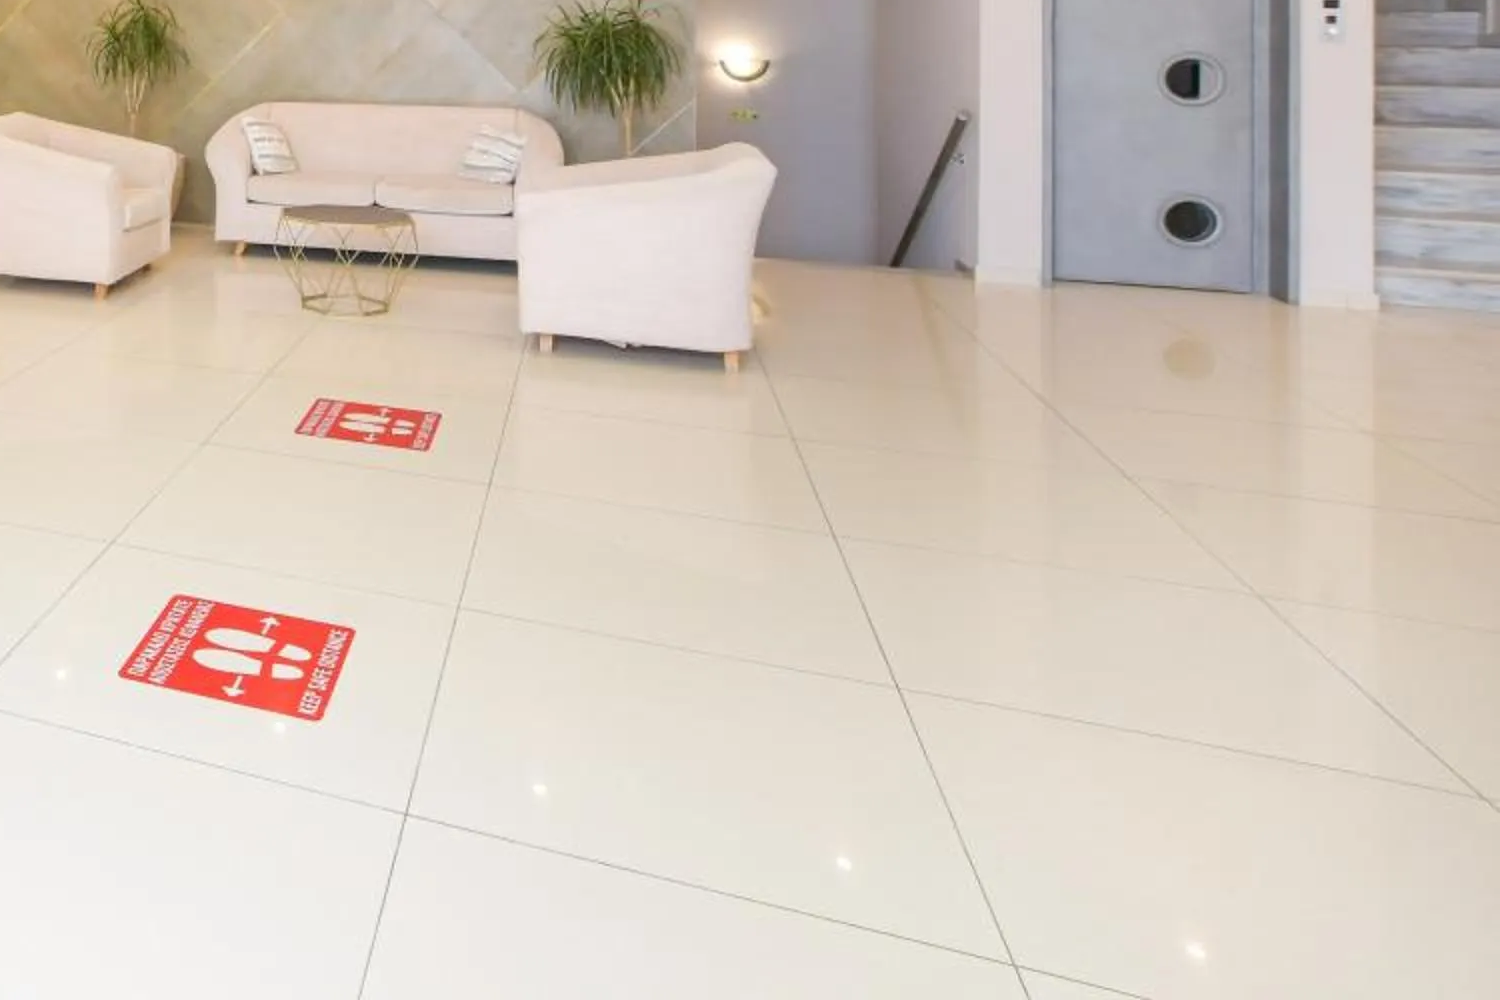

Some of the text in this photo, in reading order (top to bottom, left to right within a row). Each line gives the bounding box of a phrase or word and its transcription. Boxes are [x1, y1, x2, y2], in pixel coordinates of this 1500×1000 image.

[298, 628, 349, 715] KEEP SAFE DISTANCE
